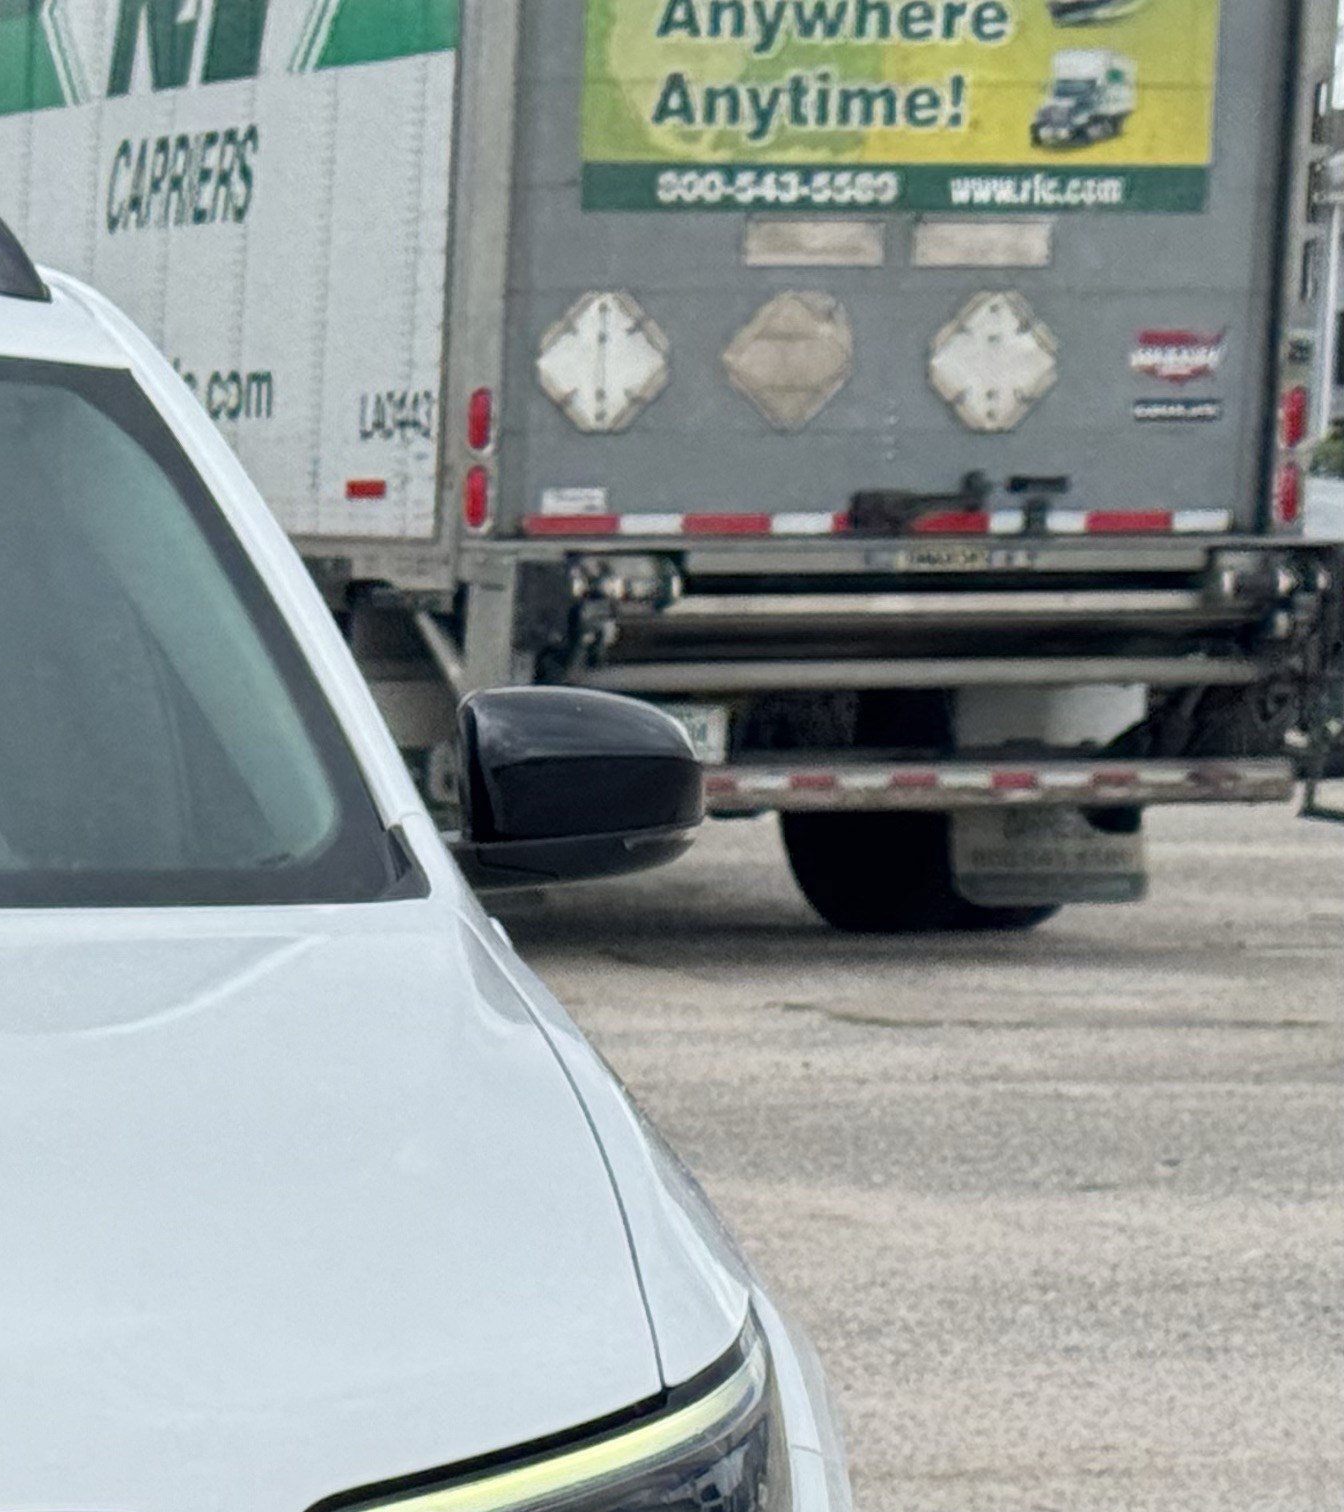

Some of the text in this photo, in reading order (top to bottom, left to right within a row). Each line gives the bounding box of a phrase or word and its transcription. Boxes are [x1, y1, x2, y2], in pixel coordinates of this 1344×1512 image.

[656, 0, 1008, 53] Anywhere
[652, 72, 965, 139] Anytime!
[107, 124, 259, 235] CARRIERS
